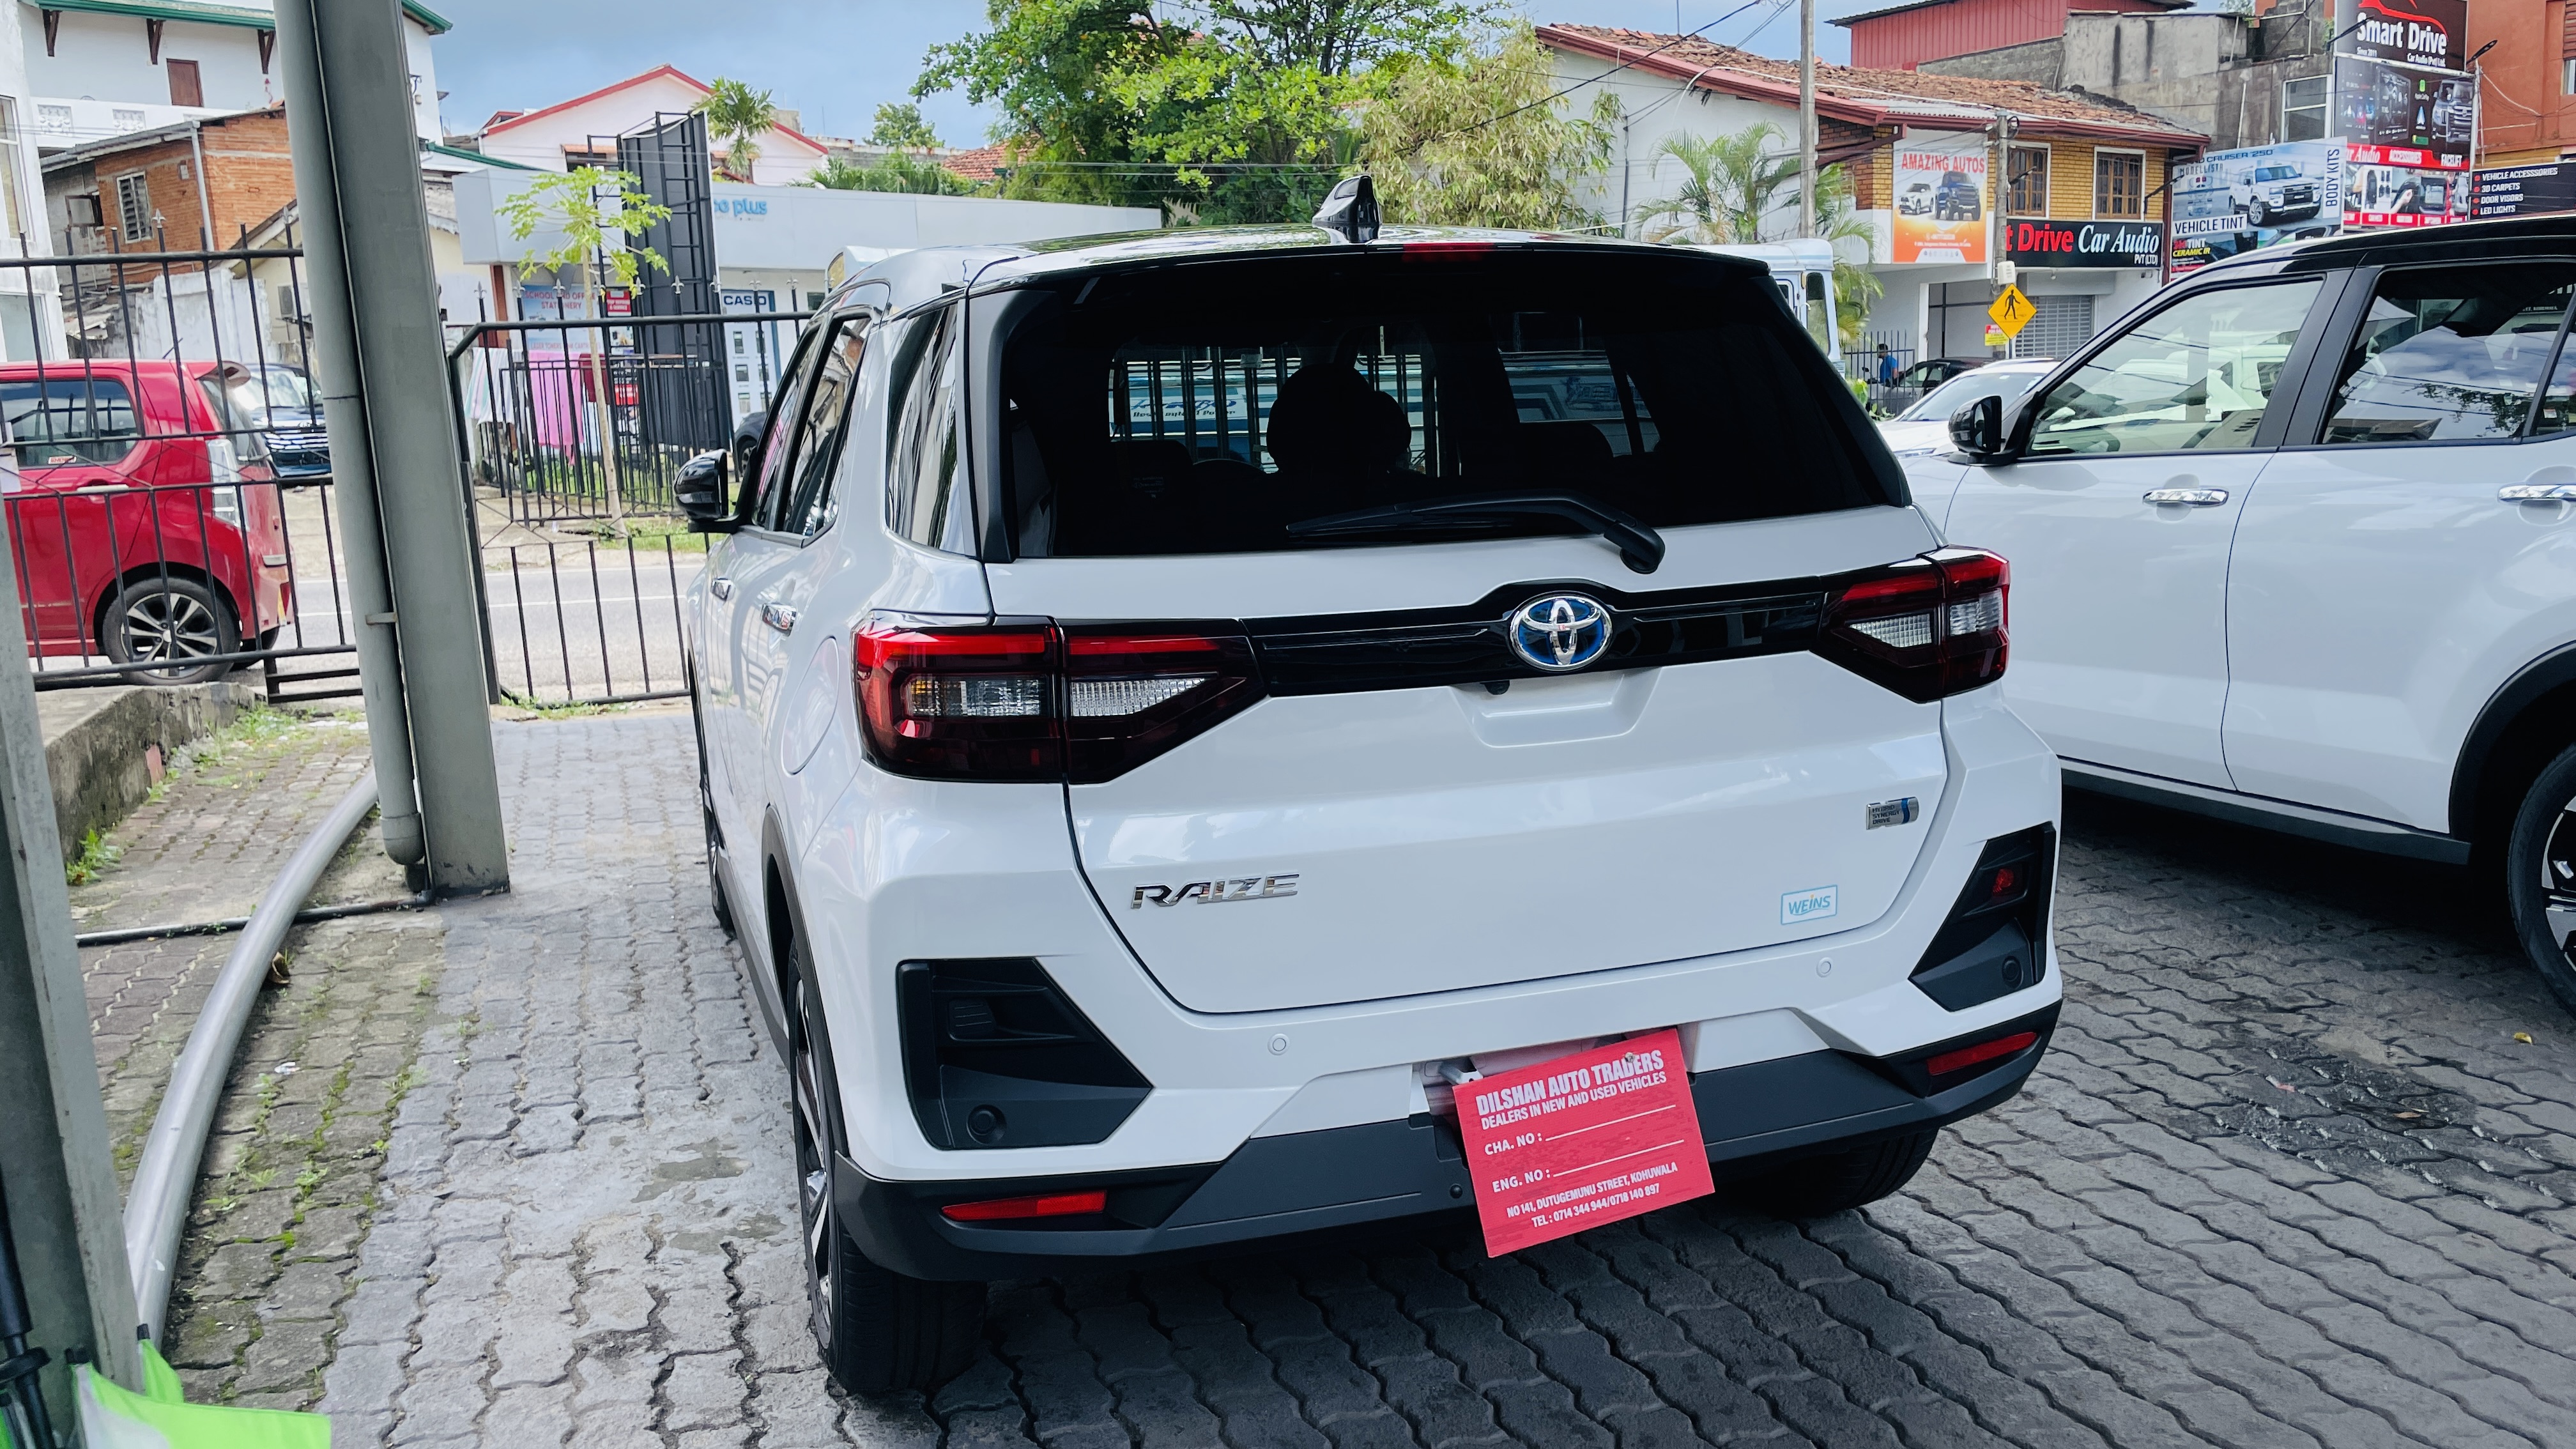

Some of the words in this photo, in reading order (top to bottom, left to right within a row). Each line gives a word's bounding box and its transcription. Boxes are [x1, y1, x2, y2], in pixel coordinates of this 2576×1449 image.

[2356, 12, 2404, 48] Smart
[2407, 22, 2448, 55] Drive
[2206, 152, 2248, 163] CRUISER
[2327, 148, 2340, 174] KITS
[2354, 144, 2380, 164] Audio
[1901, 153, 1949, 172] AMAZING
[1952, 156, 1985, 174] AUTOS
[2180, 163, 2223, 176] MODELLISTA
[2482, 171, 2509, 181] VEHICLE
[2326, 177, 2338, 207] BODY
[2481, 184, 2490, 193] 3D
[2492, 182, 2520, 192] CARPETS
[2481, 195, 2499, 204] DOOR
[2499, 193, 2524, 203] VISORS
[732, 198, 767, 217] plus
[2480, 206, 2492, 215] LED
[2493, 204, 2516, 214] LIGHTS
[2174, 218, 2218, 234] VEHICLE
[2220, 216, 2244, 230] TINT
[2017, 223, 2074, 252] Drive
[2078, 224, 2110, 254] Car
[2110, 225, 2159, 254] Audio
[2187, 238, 2206, 249] TINT
[2134, 254, 2145, 264] PVT
[2145, 254, 2158, 265] (LTD)
[2172, 248, 2203, 257] CERAMIC
[525, 291, 554, 300] SCHOOL
[723, 295, 767, 305] CASO
[541, 301, 581, 310] STATNERY
[1872, 804, 1895, 813] HYBRID
[1872, 809, 1900, 819] SYNERGY
[1130, 873, 1300, 909] RAIZE
[1475, 1078, 1547, 1116] DILSHAN
[1547, 1068, 1591, 1098] AUTO
[1591, 1049, 1664, 1086] TRADERS
[1480, 1107, 1529, 1130] DEALERS
[1529, 1102, 1541, 1117] IN
[1542, 1096, 1566, 1114] NEW
[1567, 1091, 1589, 1108] AND
[1590, 1084, 1618, 1101] USED
[1618, 1070, 1667, 1094] VEHICLES
[1484, 1138, 1515, 1156] CHA.
[1492, 1176, 1522, 1193] ENG.
[1506, 1205, 1521, 1218] NO
[1536, 1183, 1597, 1209] DUTUGEMUNU
[1597, 1174, 1630, 1193] STREET,
[1630, 1161, 1678, 1184] KOHUWALA
[1553, 1208, 1573, 1222] 0714
[1573, 1204, 1590, 1216] 344
[1629, 1188, 1644, 1201] 140
[1644, 1182, 1660, 1197] 897
